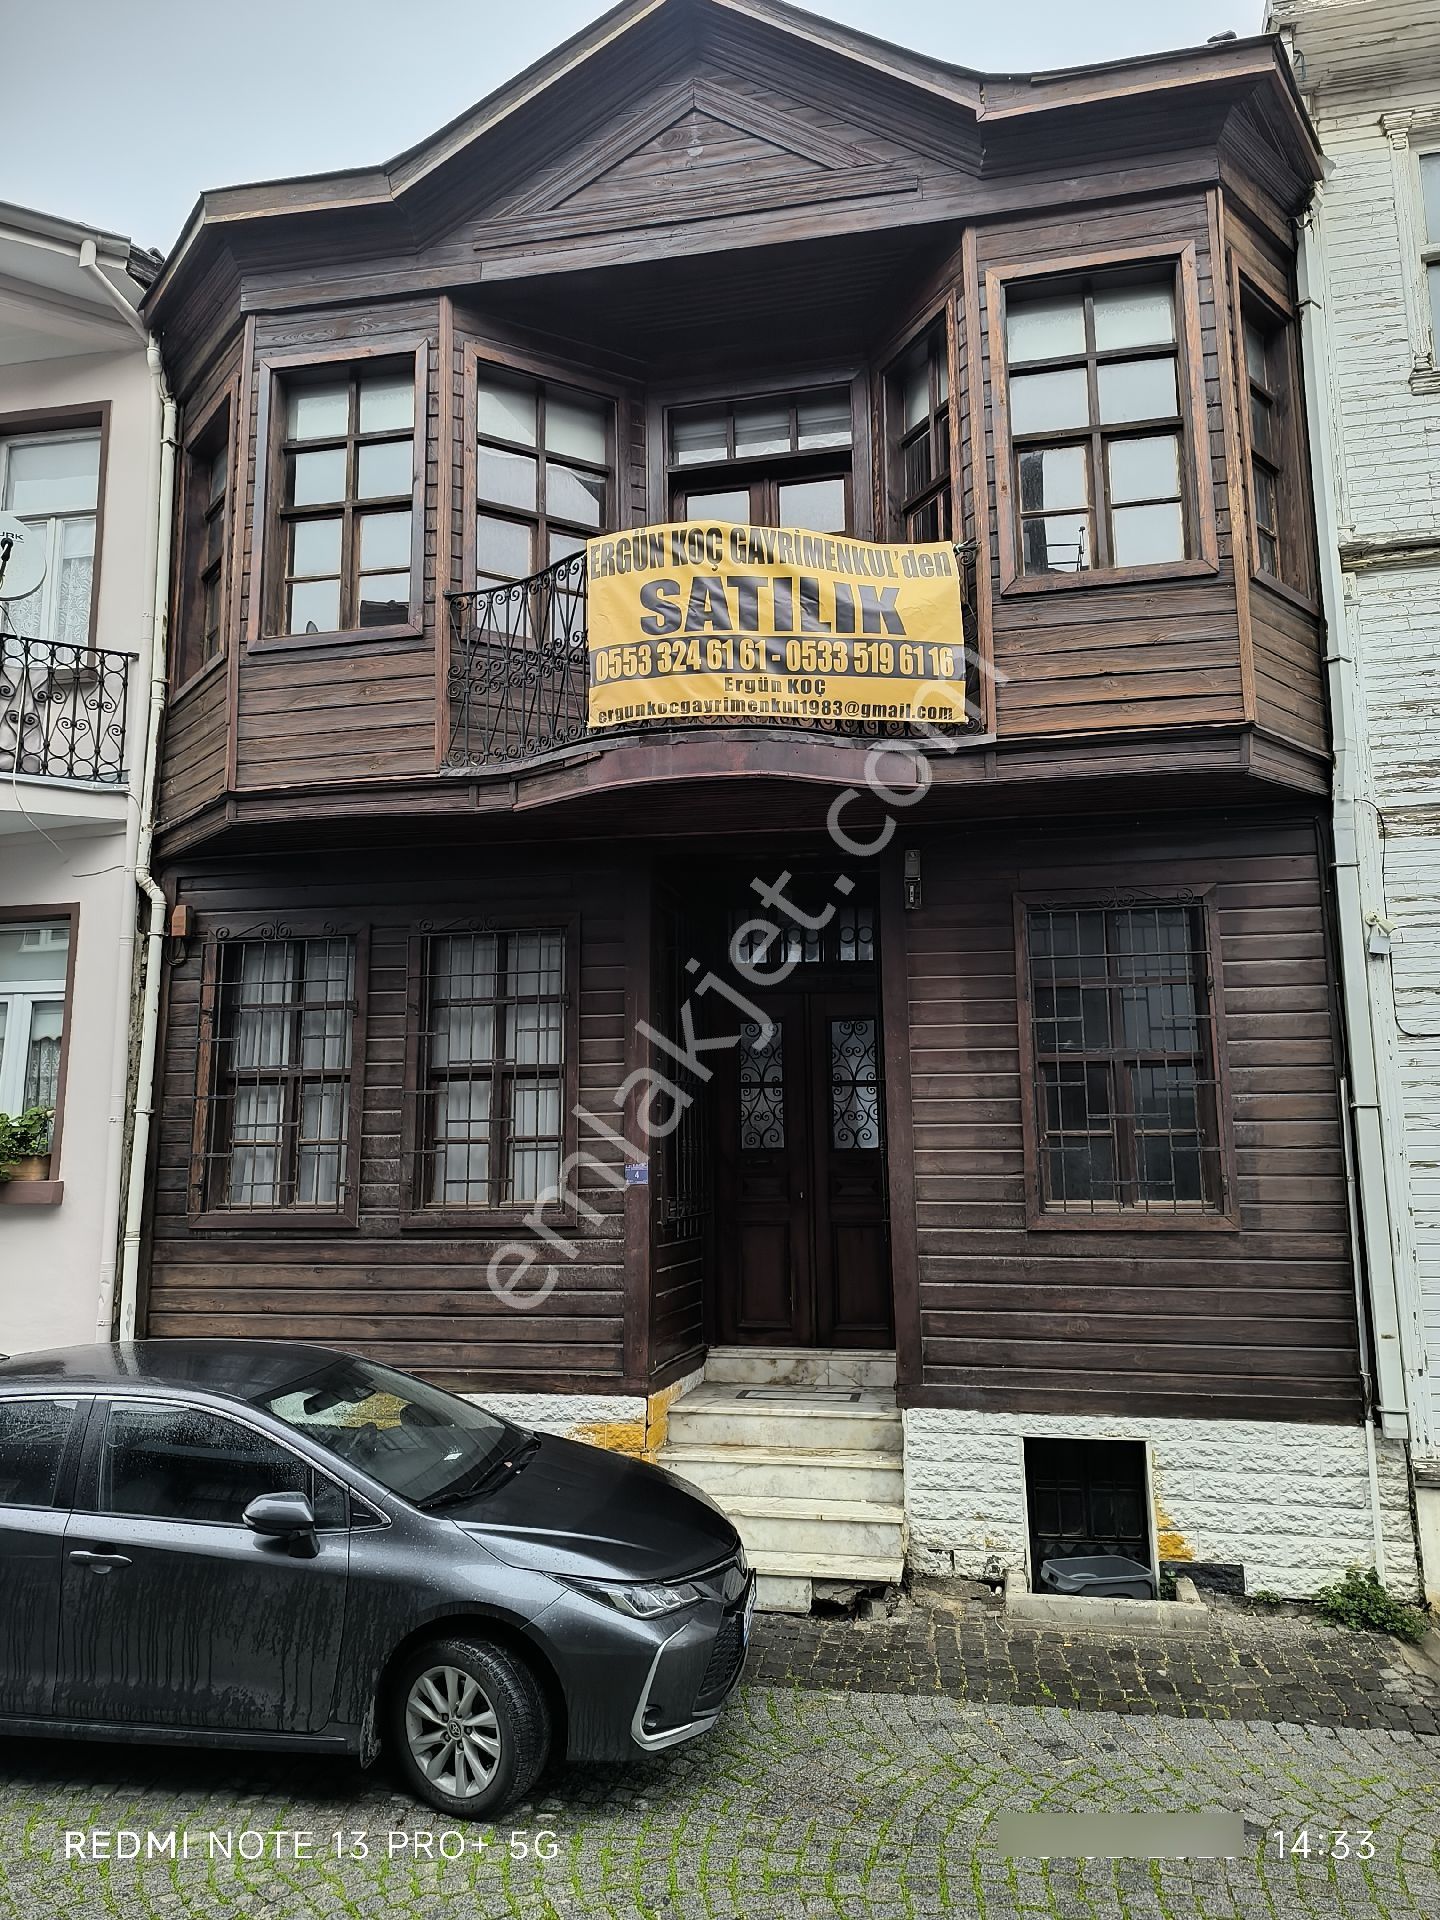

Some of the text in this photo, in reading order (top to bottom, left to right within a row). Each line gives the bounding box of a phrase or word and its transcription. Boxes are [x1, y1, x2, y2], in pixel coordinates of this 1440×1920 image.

[590, 529, 665, 580] ERGÜN
[671, 527, 724, 571] KOÇ
[640, 576, 907, 635] SATILIK
[595, 638, 955, 682] 0553 324 61 61 - 0533 519 61 16
[724, 676, 826, 697] Ergün KOÇ
[598, 696, 954, 724] ergunkocgayrimenkul1983@gmail.com
